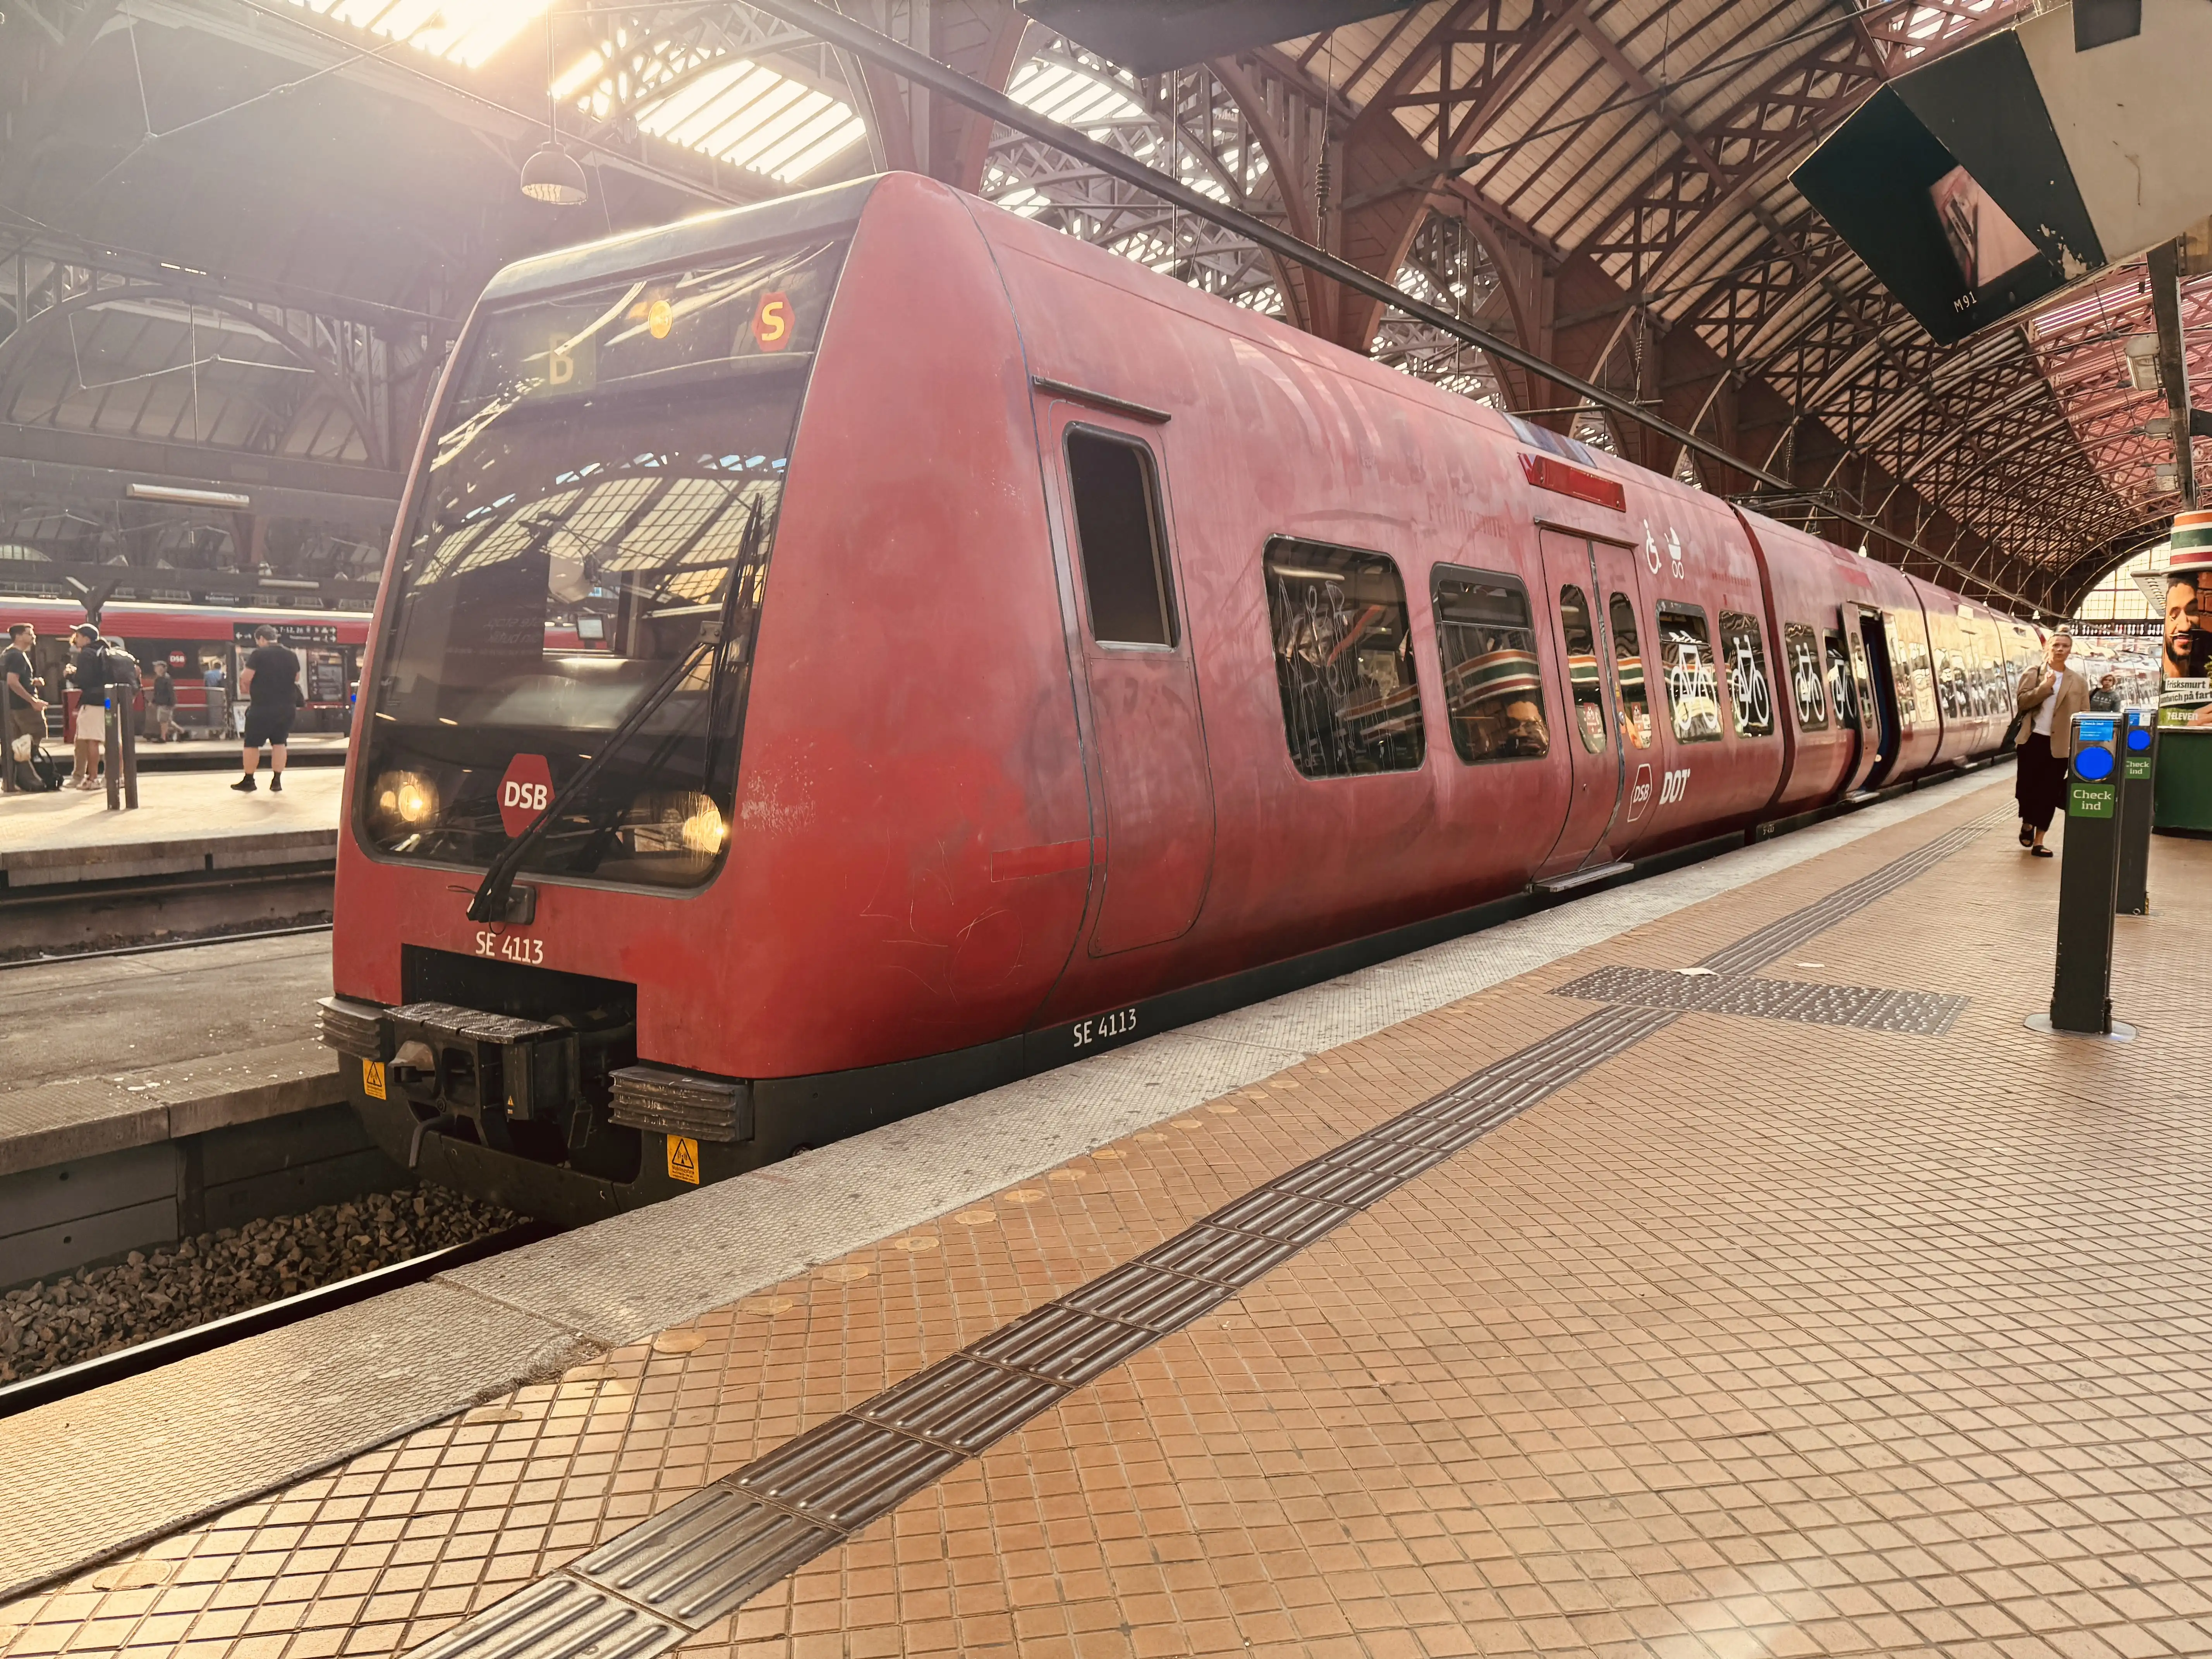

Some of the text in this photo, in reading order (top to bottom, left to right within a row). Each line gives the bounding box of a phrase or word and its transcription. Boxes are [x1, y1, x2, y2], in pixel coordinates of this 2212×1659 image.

[1954, 291, 1977, 312] M91
[761, 301, 785, 341] S
[2167, 680, 2206, 689] Frisksmurt
[2184, 690, 2194, 702] på
[505, 781, 547, 810] DSB
[1633, 783, 1650, 803] DSB
[2073, 790, 2111, 800] Check
[2081, 801, 2101, 810] ind
[476, 931, 543, 964] SE 4113
[1074, 1008, 1136, 1047] SE 4113
